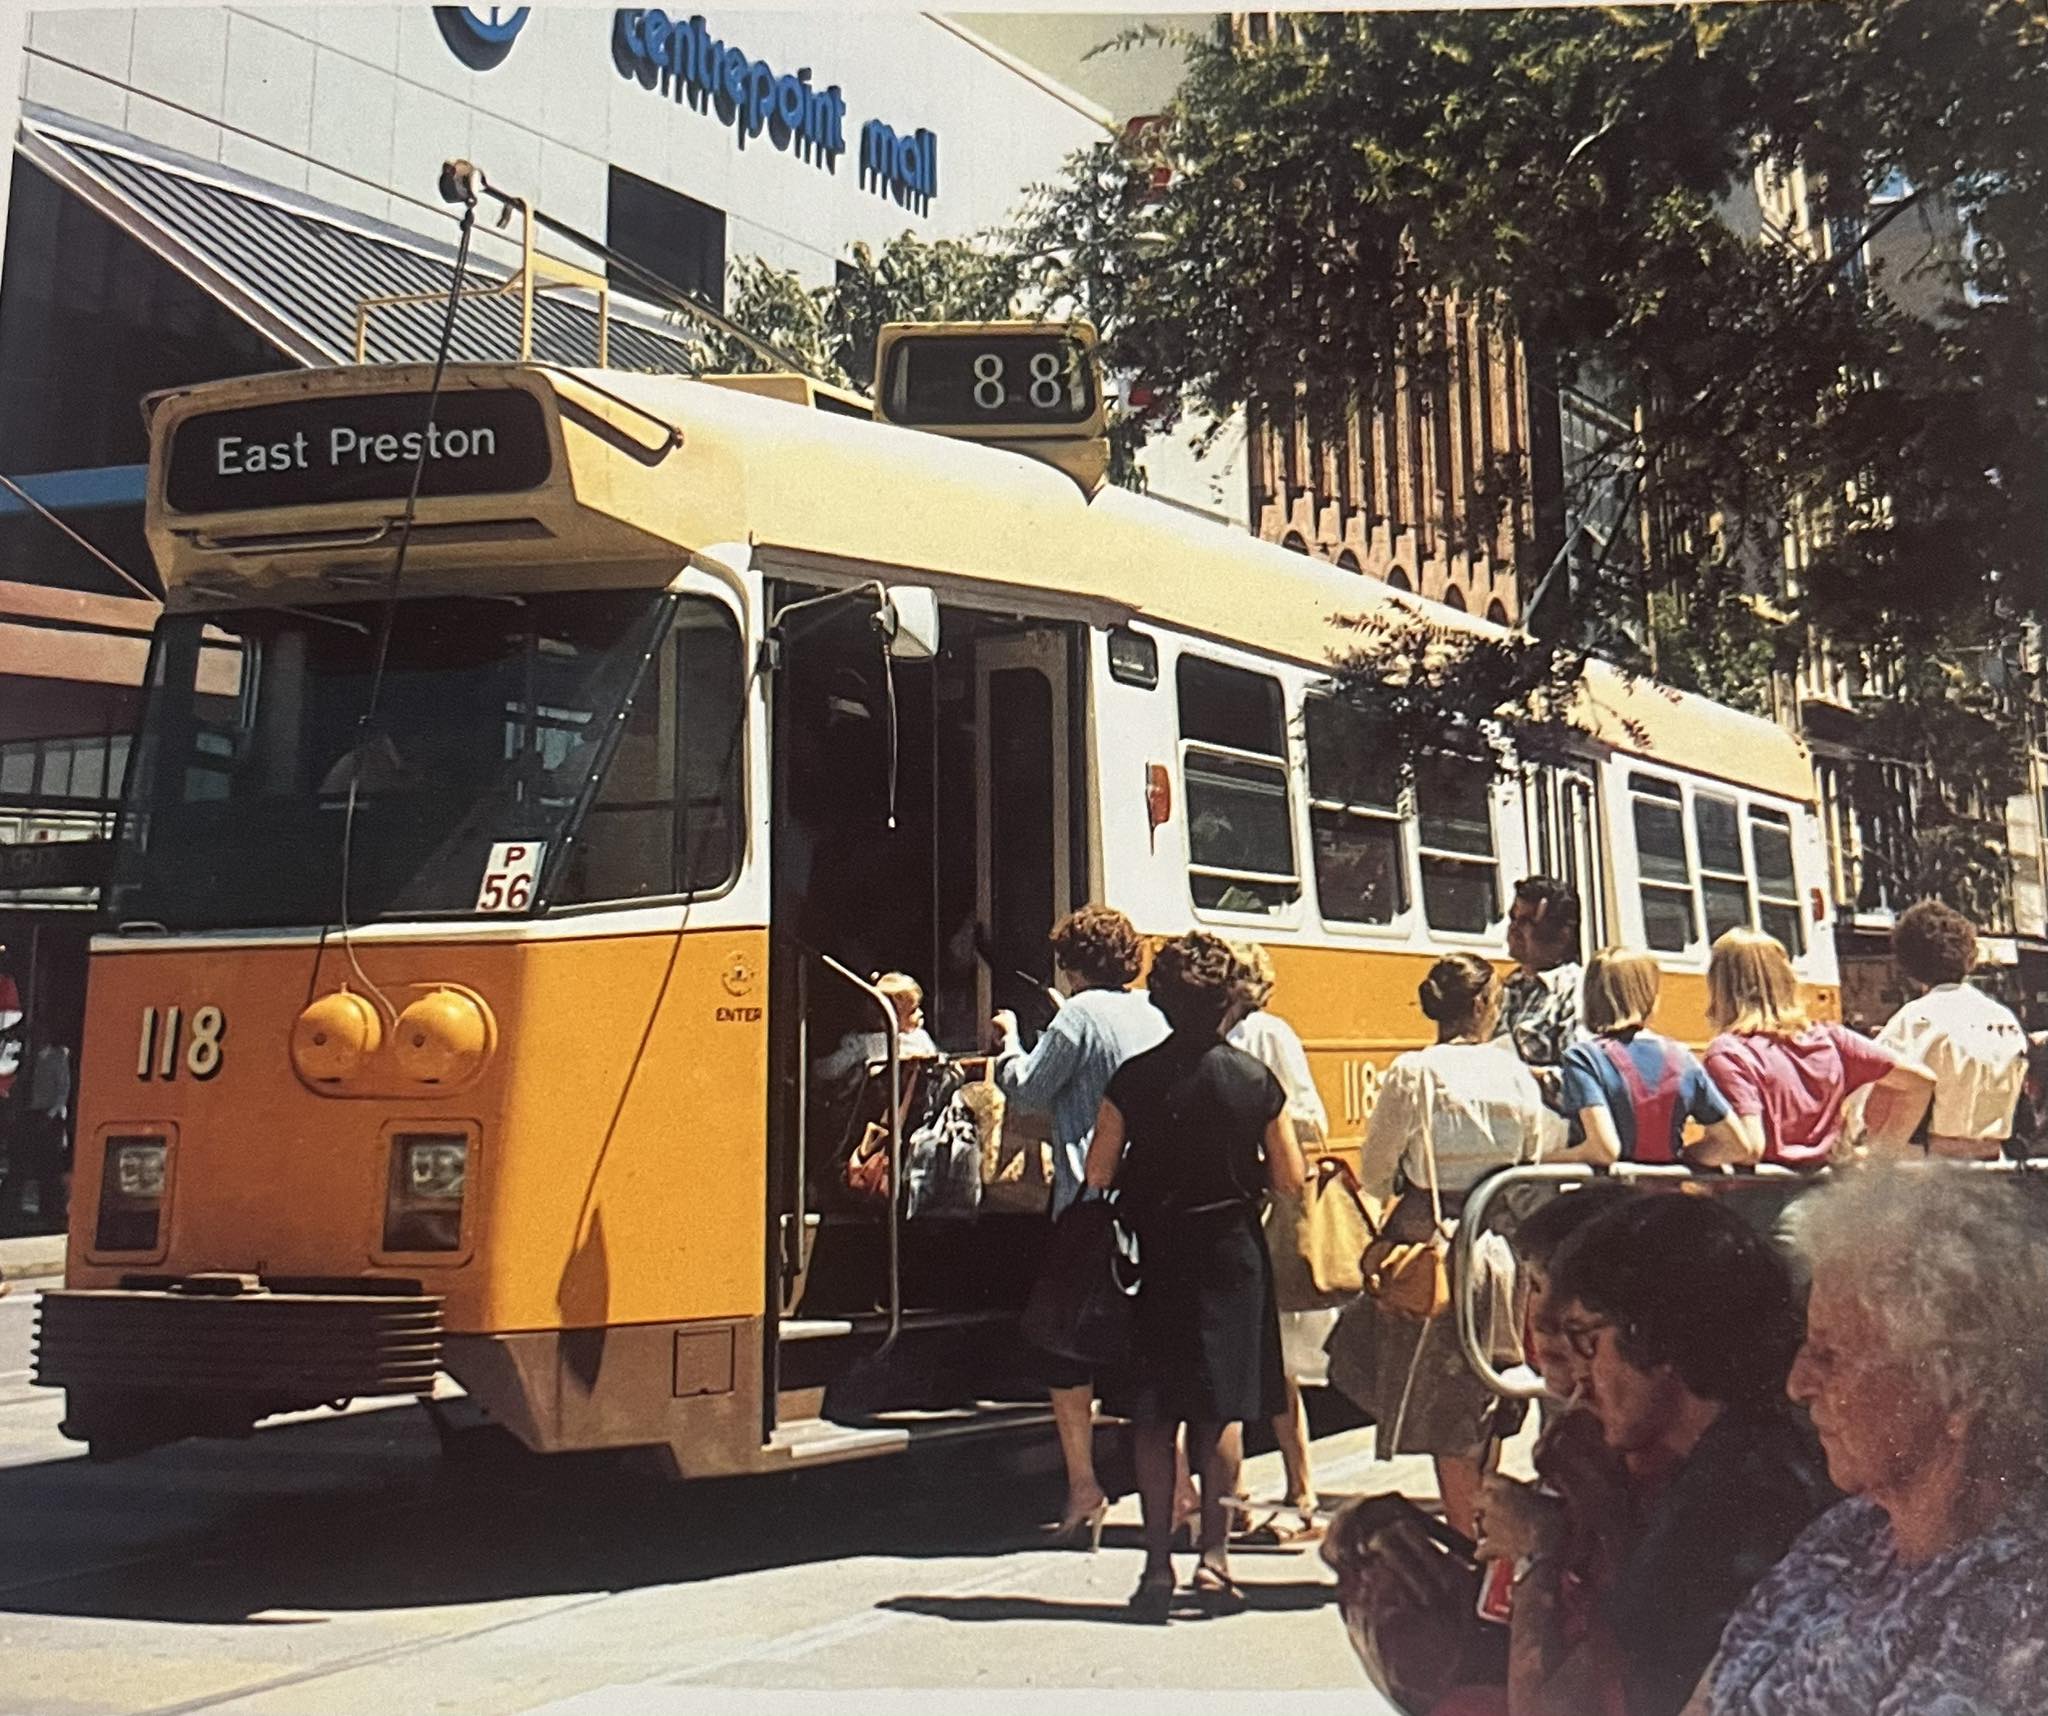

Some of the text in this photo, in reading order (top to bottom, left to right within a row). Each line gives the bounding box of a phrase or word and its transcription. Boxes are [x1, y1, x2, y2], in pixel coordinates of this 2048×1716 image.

[864, 118, 938, 199] mall
[217, 422, 496, 475] East Preston
[503, 846, 526, 868] P
[481, 873, 531, 911] 56
[715, 1006, 762, 1022] ENTER
[137, 1005, 223, 1077] 118
[1343, 1059, 1378, 1120] 118
